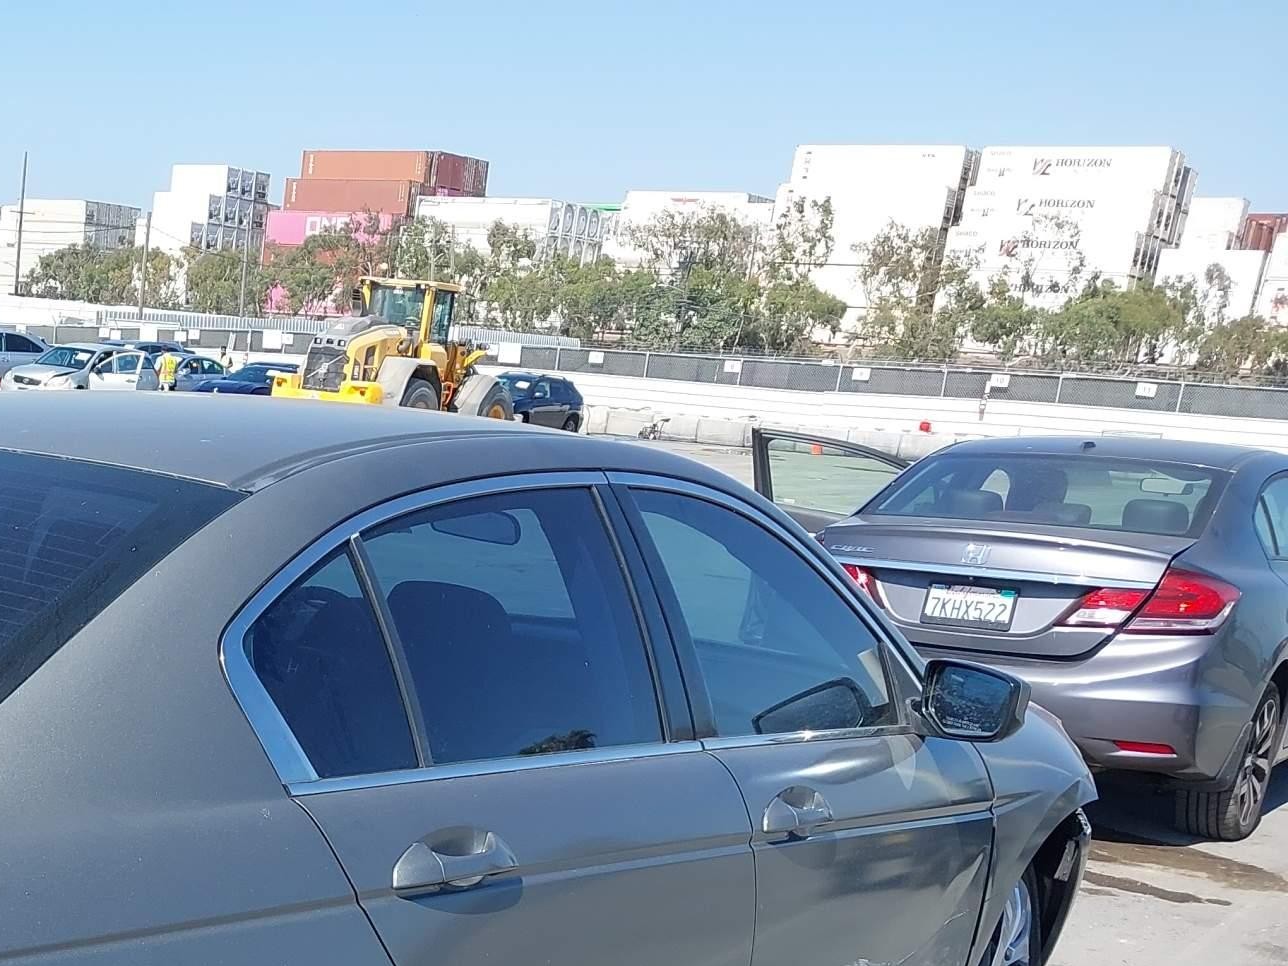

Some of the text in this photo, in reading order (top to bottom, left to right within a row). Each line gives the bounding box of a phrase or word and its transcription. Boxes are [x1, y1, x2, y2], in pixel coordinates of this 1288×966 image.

[1055, 158, 1112, 168] HORIZON
[1038, 199, 1096, 209] HORIZON
[1020, 239, 1080, 250] HORIZON
[930, 596, 1008, 623] 7KHX522
